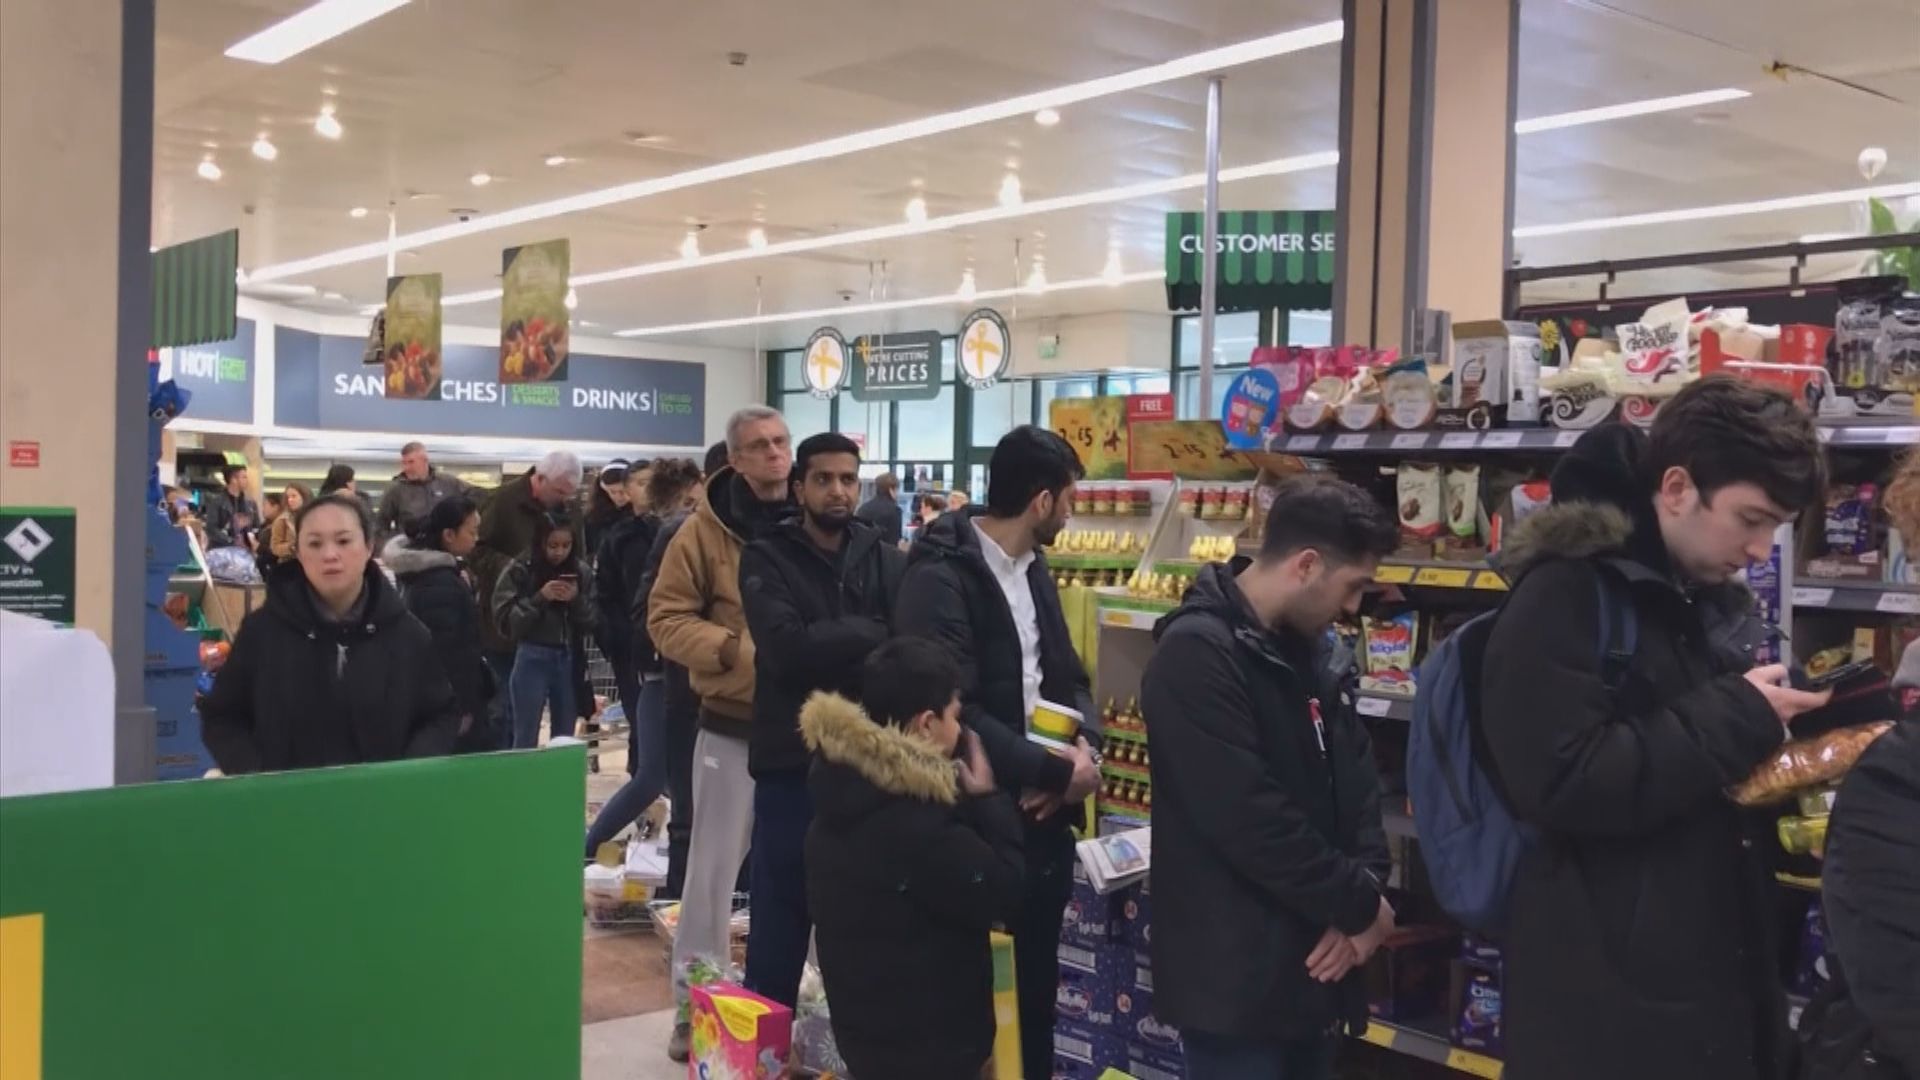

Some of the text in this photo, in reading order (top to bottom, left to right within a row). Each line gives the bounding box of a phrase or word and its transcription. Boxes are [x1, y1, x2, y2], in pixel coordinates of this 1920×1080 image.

[1179, 233, 1304, 253] CUSTOMER
[180, 349, 214, 378] HOT
[893, 350, 929, 362] CUTTING
[866, 363, 928, 383] PRICES
[334, 373, 498, 402] SANCHES
[1240, 374, 1275, 401] New
[572, 387, 651, 412] DRINKS
[1139, 400, 1163, 412] FREE
